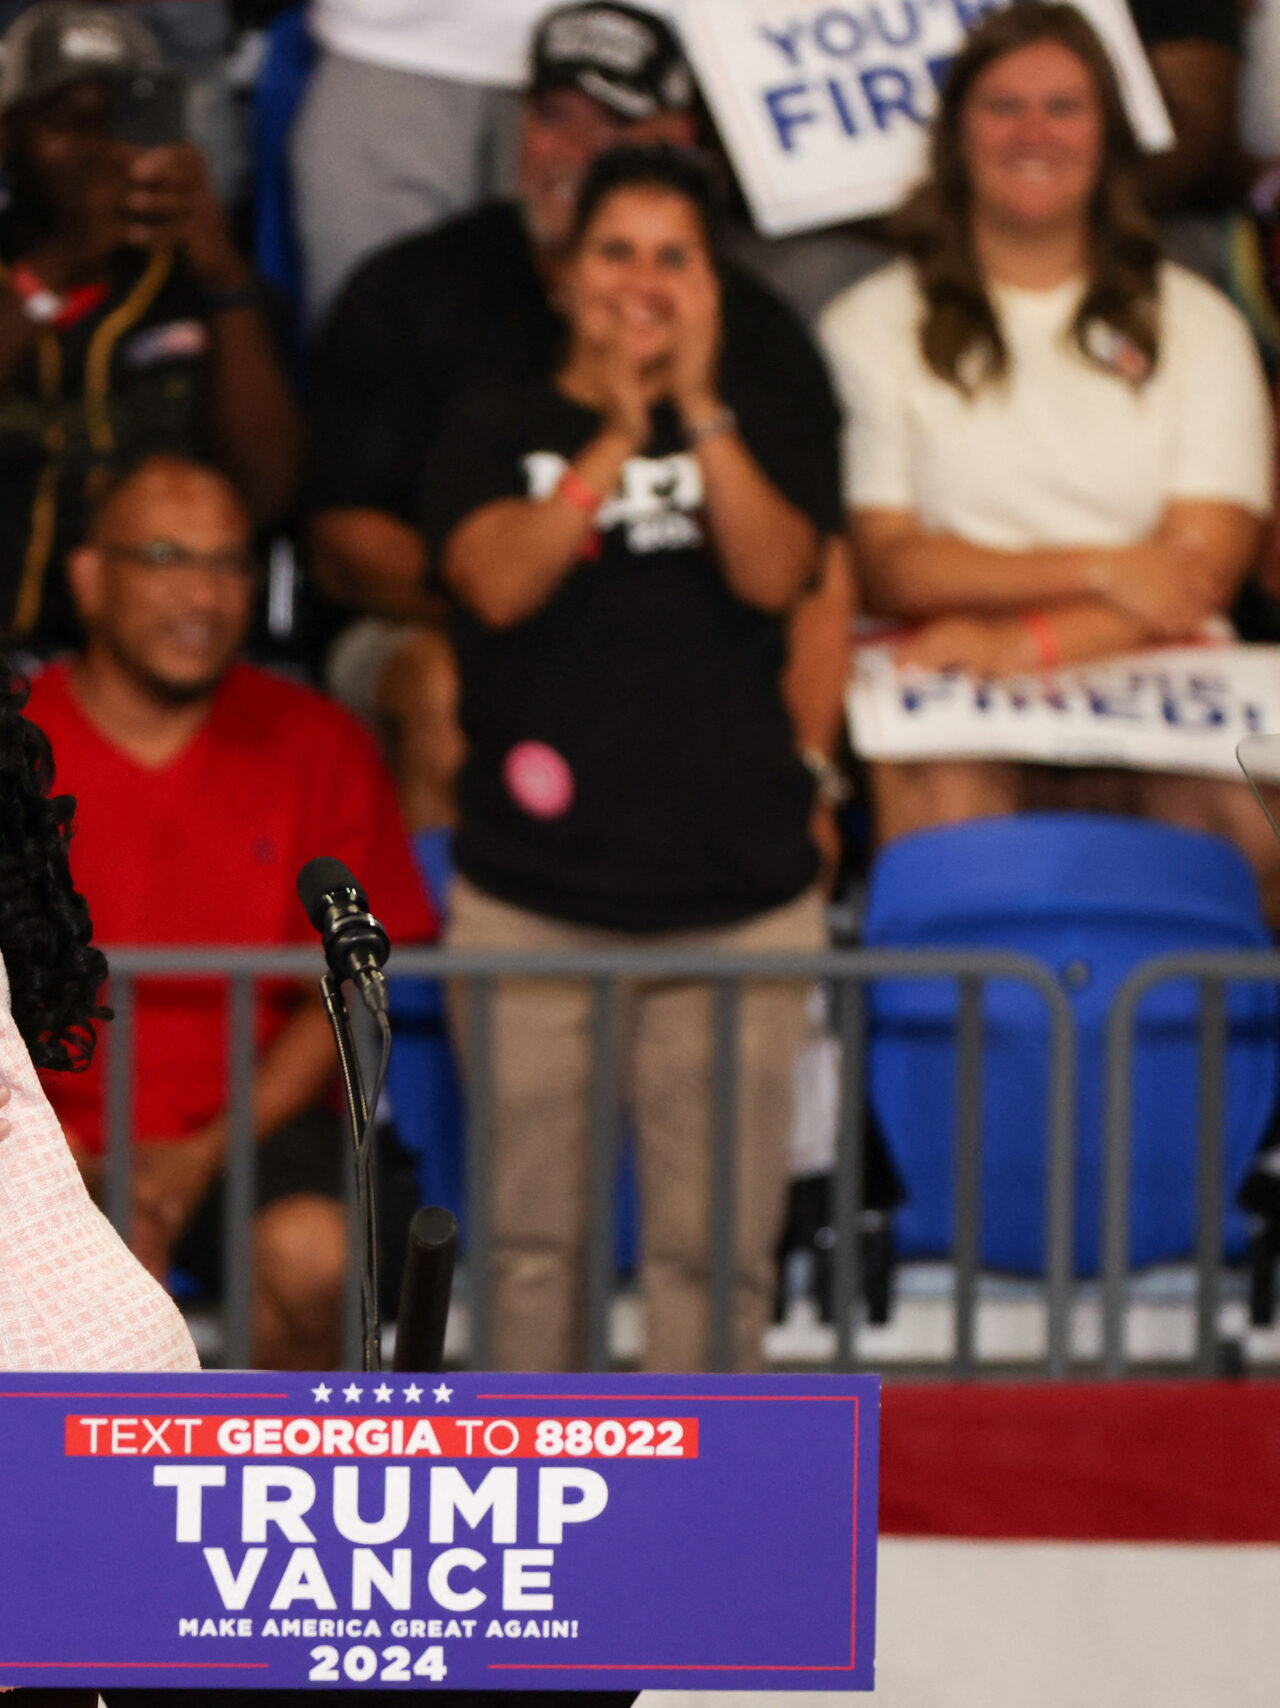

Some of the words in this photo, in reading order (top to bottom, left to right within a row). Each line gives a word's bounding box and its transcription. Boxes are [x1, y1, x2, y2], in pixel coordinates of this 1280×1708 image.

[763, 54, 960, 153] FIR
[80, 1418, 203, 1455] TEXT
[217, 1418, 442, 1456] GEORGIA
[455, 1419, 520, 1457] TO
[534, 1419, 685, 1457] 88022
[152, 1464, 609, 1545] TRUMP
[202, 1547, 554, 1612] VANCE
[178, 1618, 253, 1638] MAKE
[261, 1618, 382, 1639] AMERICA
[390, 1619, 477, 1639] GREAT
[485, 1619, 579, 1639] AGAIN!
[308, 1644, 448, 1683] 2024
